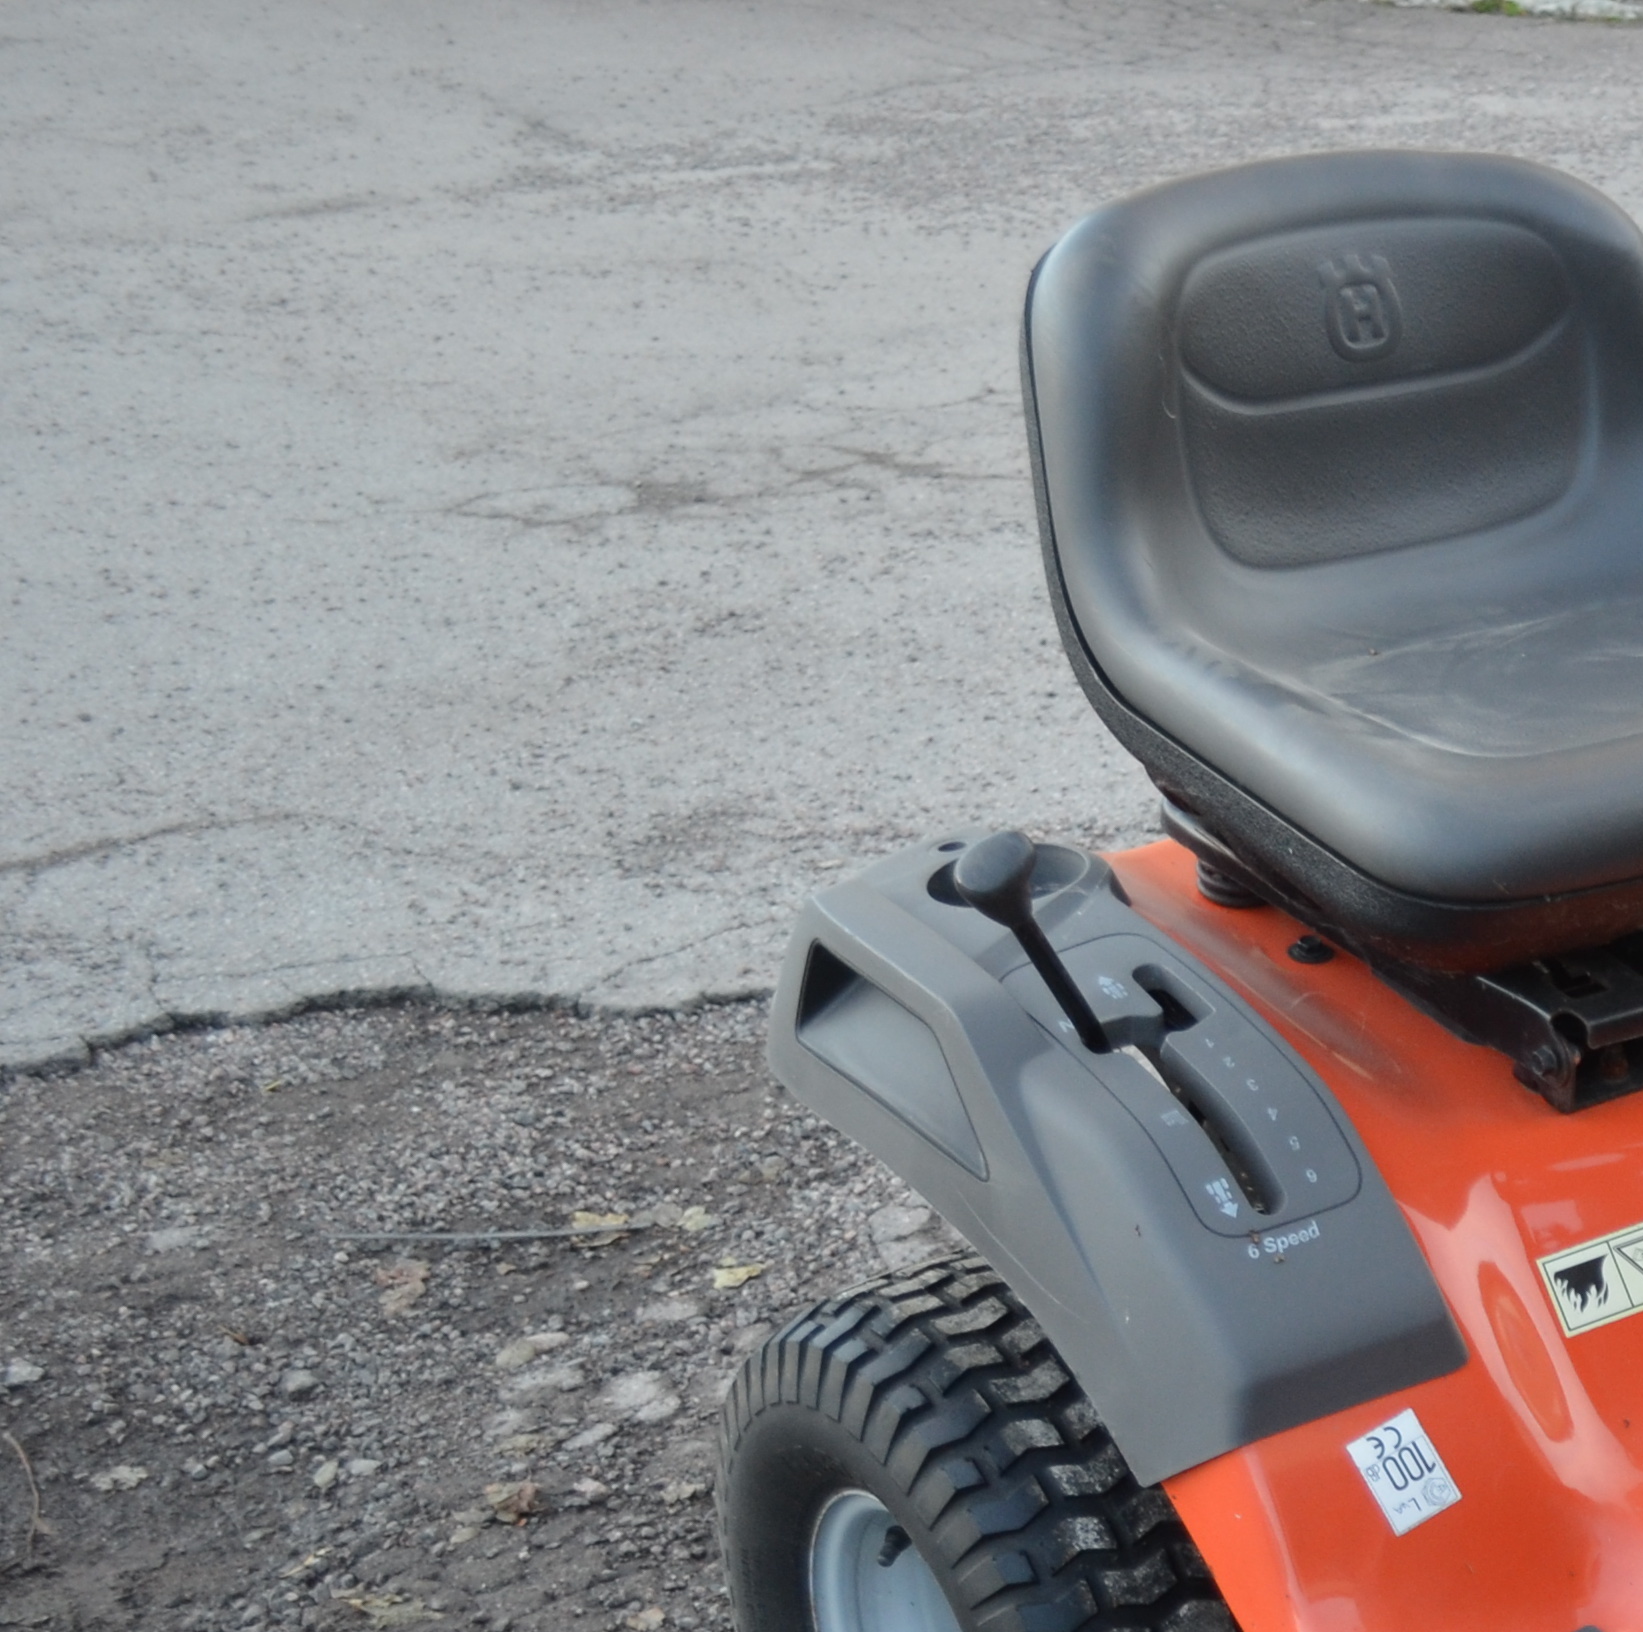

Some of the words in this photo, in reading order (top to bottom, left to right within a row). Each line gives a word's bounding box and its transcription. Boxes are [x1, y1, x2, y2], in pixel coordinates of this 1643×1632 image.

[1222, 1056, 1236, 1069] 2
[1246, 1078, 1259, 1092] 3
[1267, 1106, 1279, 1122] 4
[1289, 1135, 1301, 1151] 5
[1247, 1243, 1260, 1259] 6
[1263, 1220, 1321, 1254] Speed
[1381, 1440, 1437, 1491] 100
